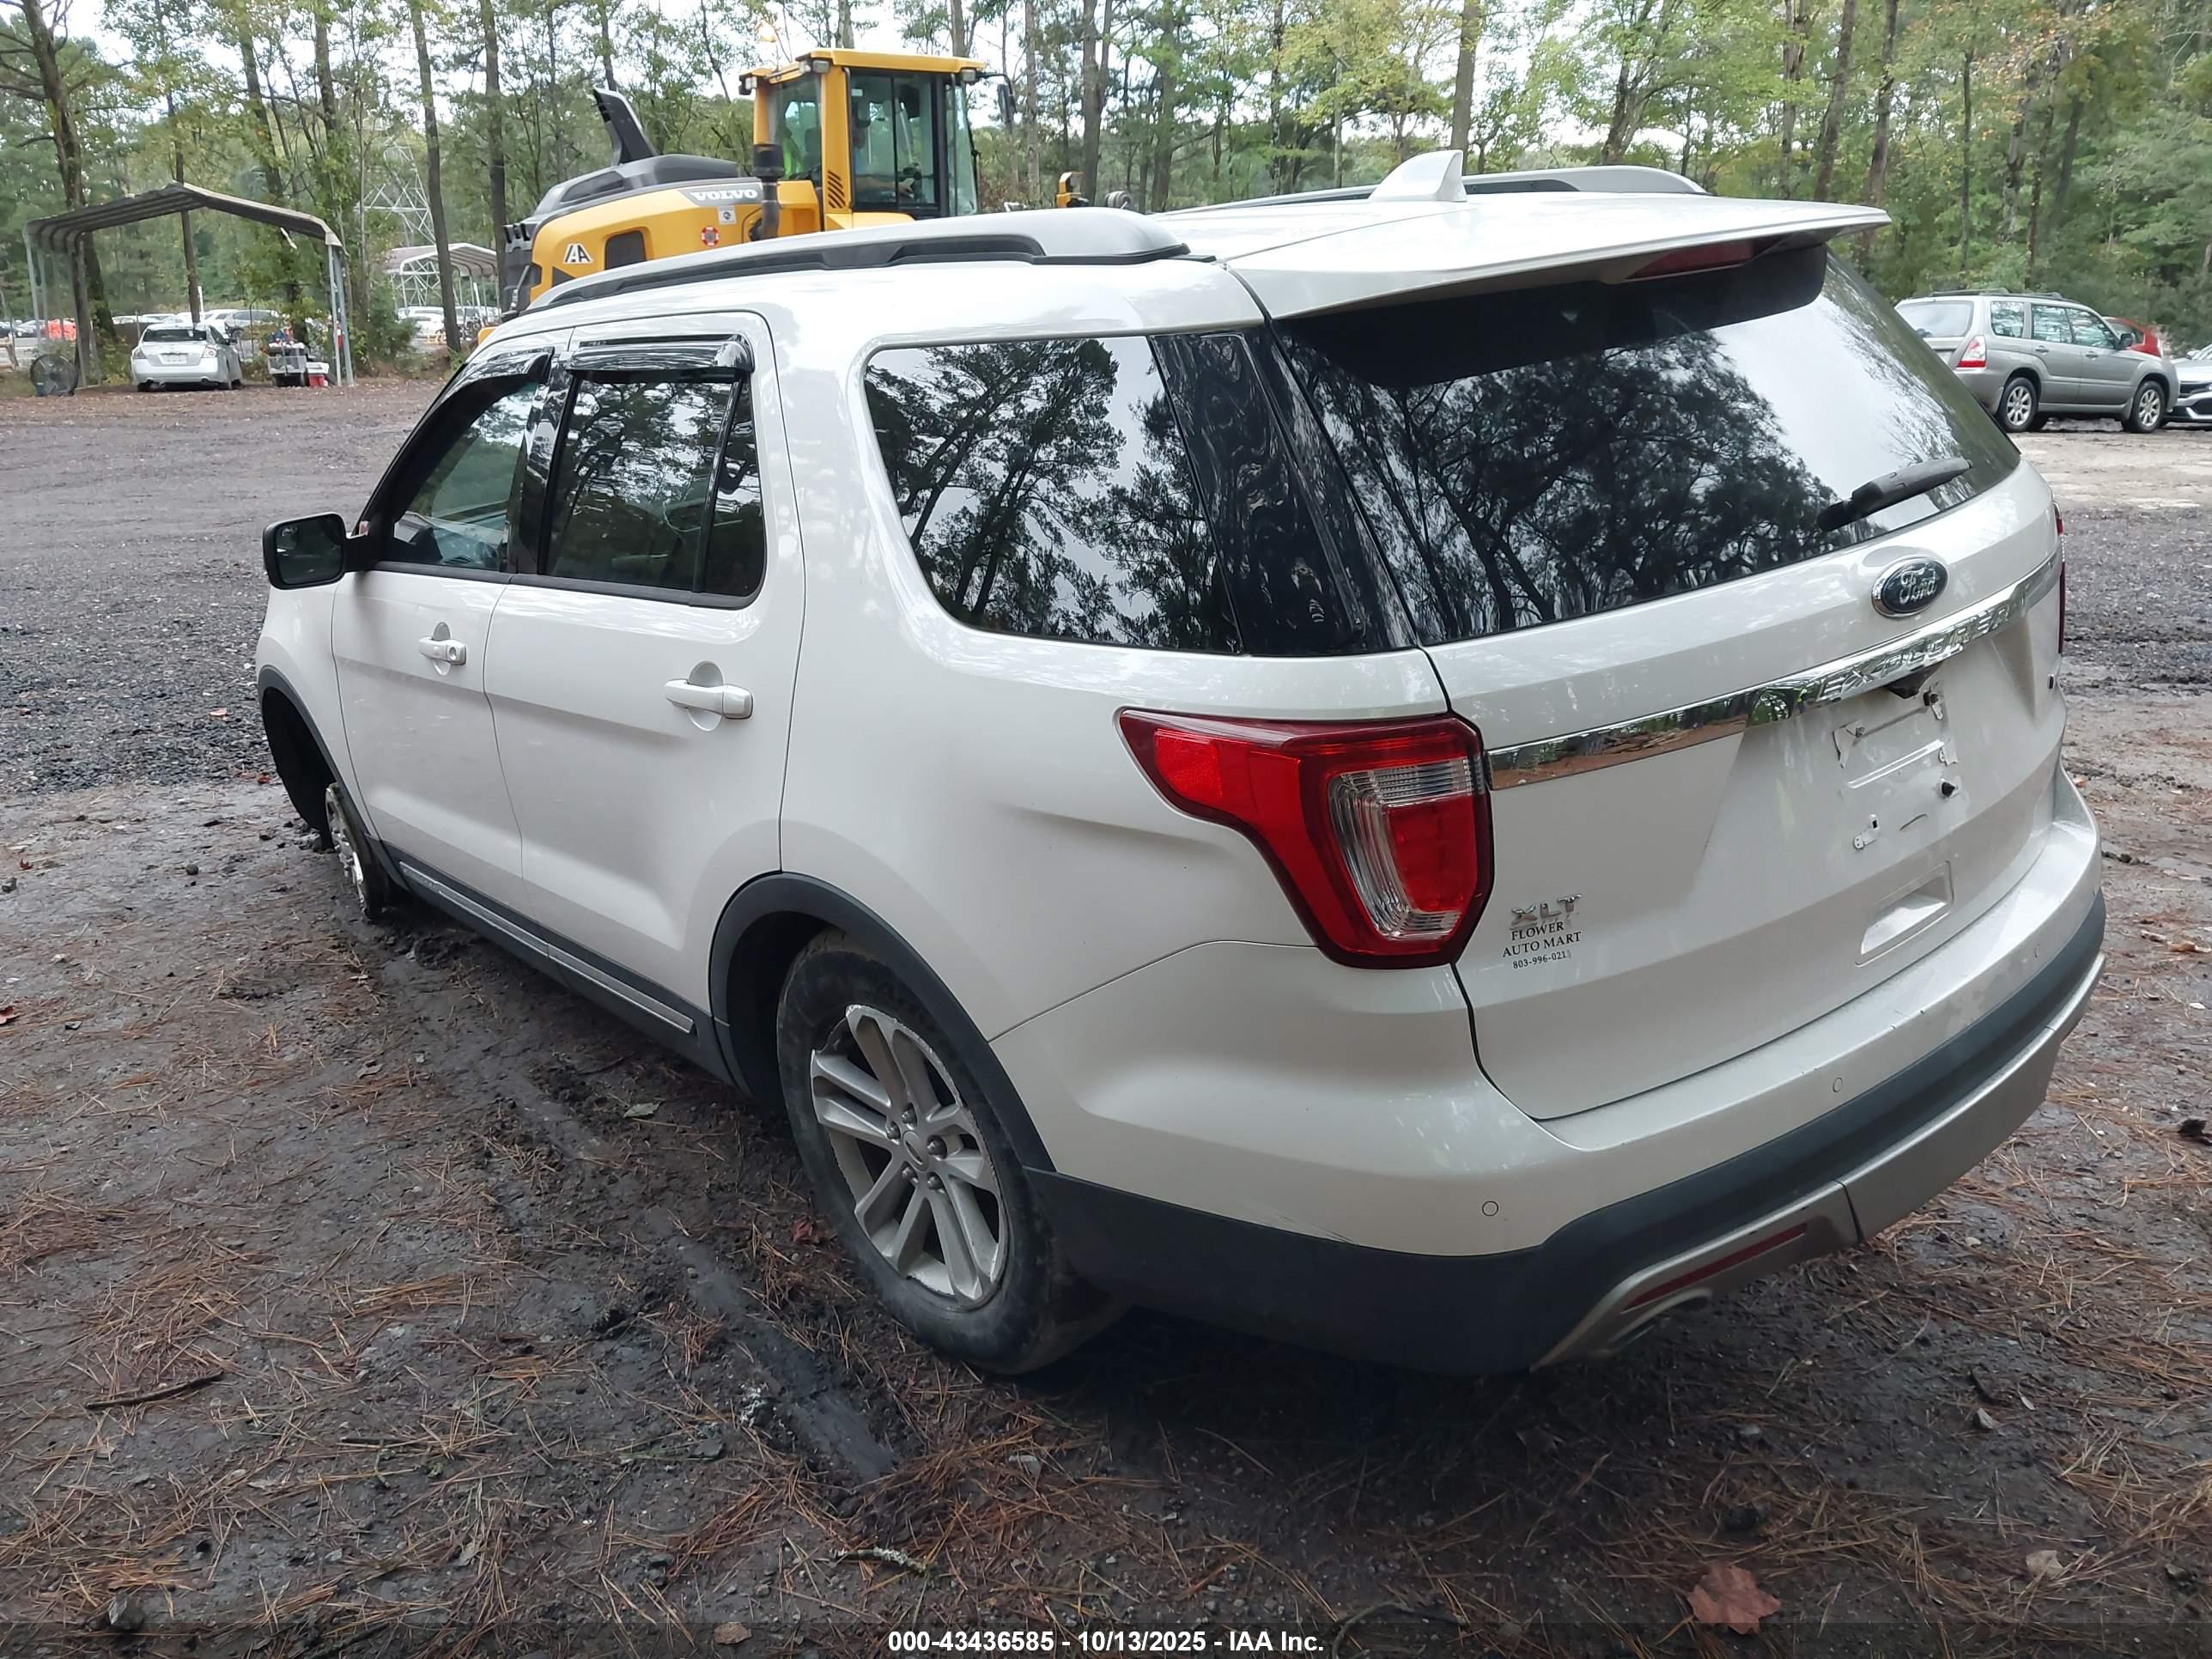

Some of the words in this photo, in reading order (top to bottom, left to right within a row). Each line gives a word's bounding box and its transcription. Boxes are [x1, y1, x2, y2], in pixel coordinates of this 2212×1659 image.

[690, 189, 758, 201] VOLVO
[1899, 567, 1938, 605] Ford
[1816, 605, 2010, 702] EXPLORER
[1510, 894, 1582, 926] XLT
[1503, 940, 1540, 957] AUTO
[1543, 932, 1582, 949] MART
[1511, 921, 1565, 941] FLOWER
